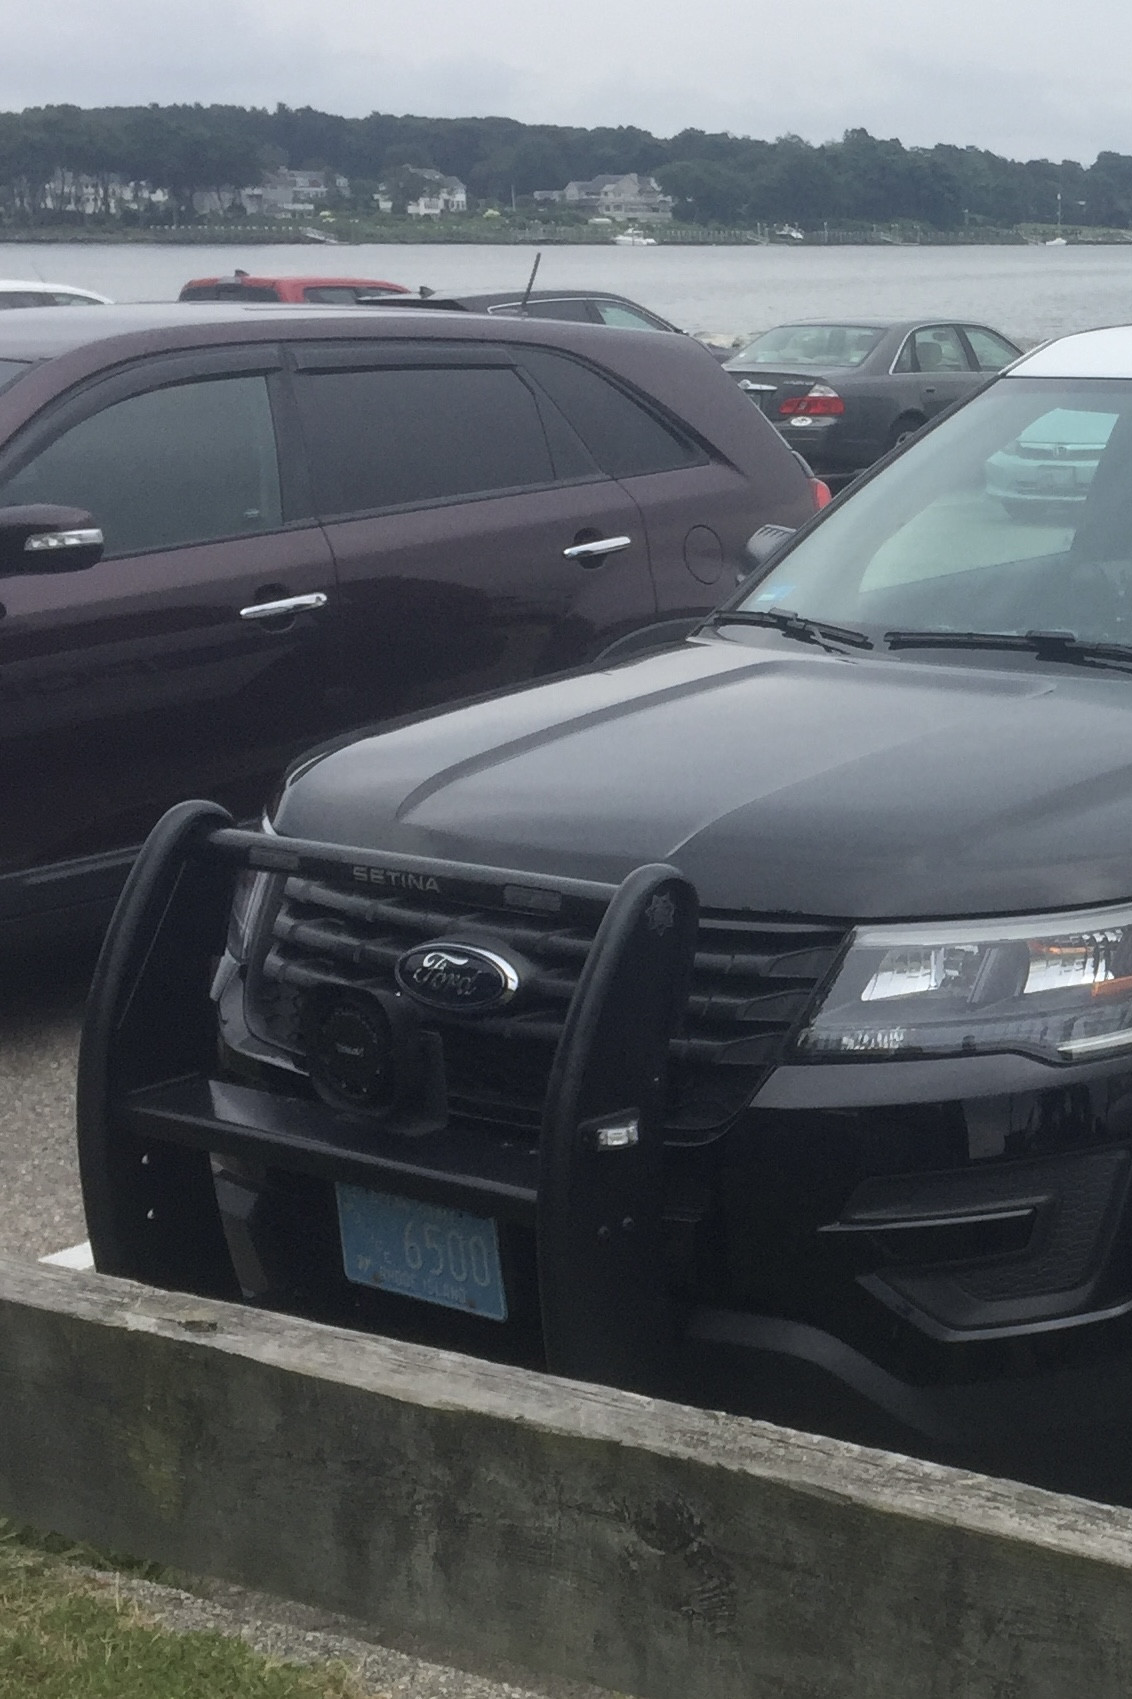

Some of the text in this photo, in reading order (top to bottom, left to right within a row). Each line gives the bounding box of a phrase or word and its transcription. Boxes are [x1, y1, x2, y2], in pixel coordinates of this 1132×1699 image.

[353, 866, 440, 893] SETINA
[413, 952, 482, 996] Ford
[403, 1221, 490, 1287] 6500
